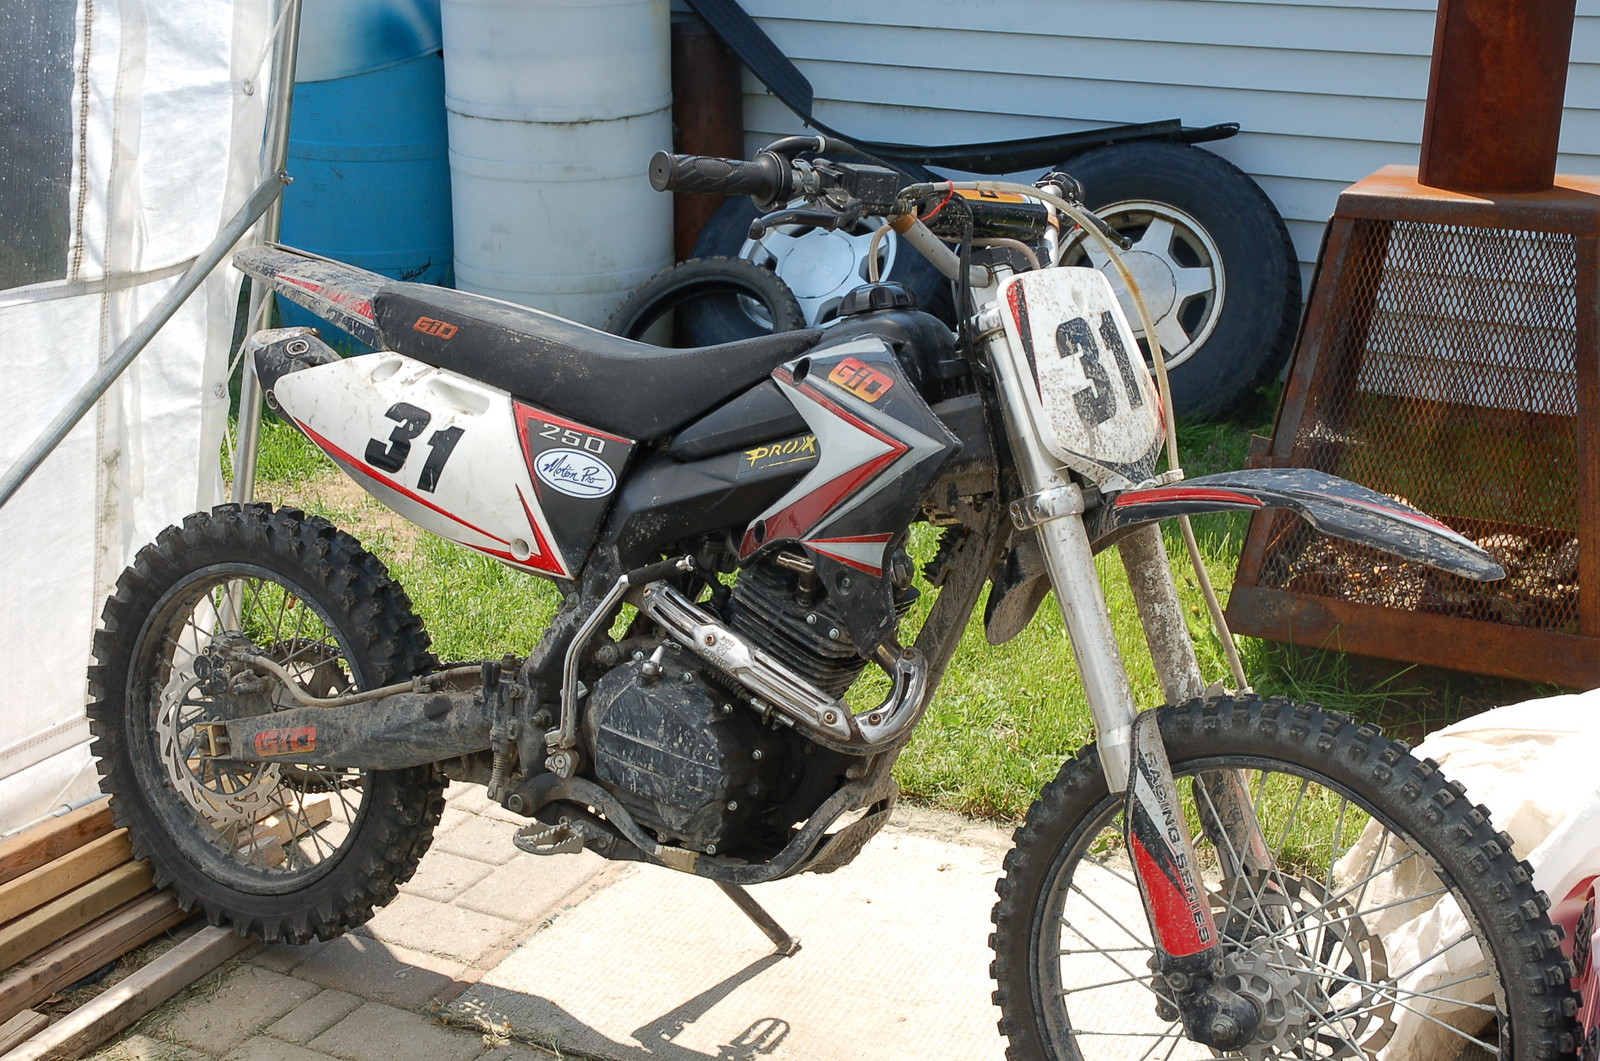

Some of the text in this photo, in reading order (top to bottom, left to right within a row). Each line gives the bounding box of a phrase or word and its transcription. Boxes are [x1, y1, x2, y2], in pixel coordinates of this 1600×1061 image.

[1055, 310, 1143, 427] 31
[365, 402, 466, 494] 31
[538, 422, 606, 454] 250
[542, 454, 607, 484] Motion Pro
[1143, 751, 1211, 944] RACING SERIES
